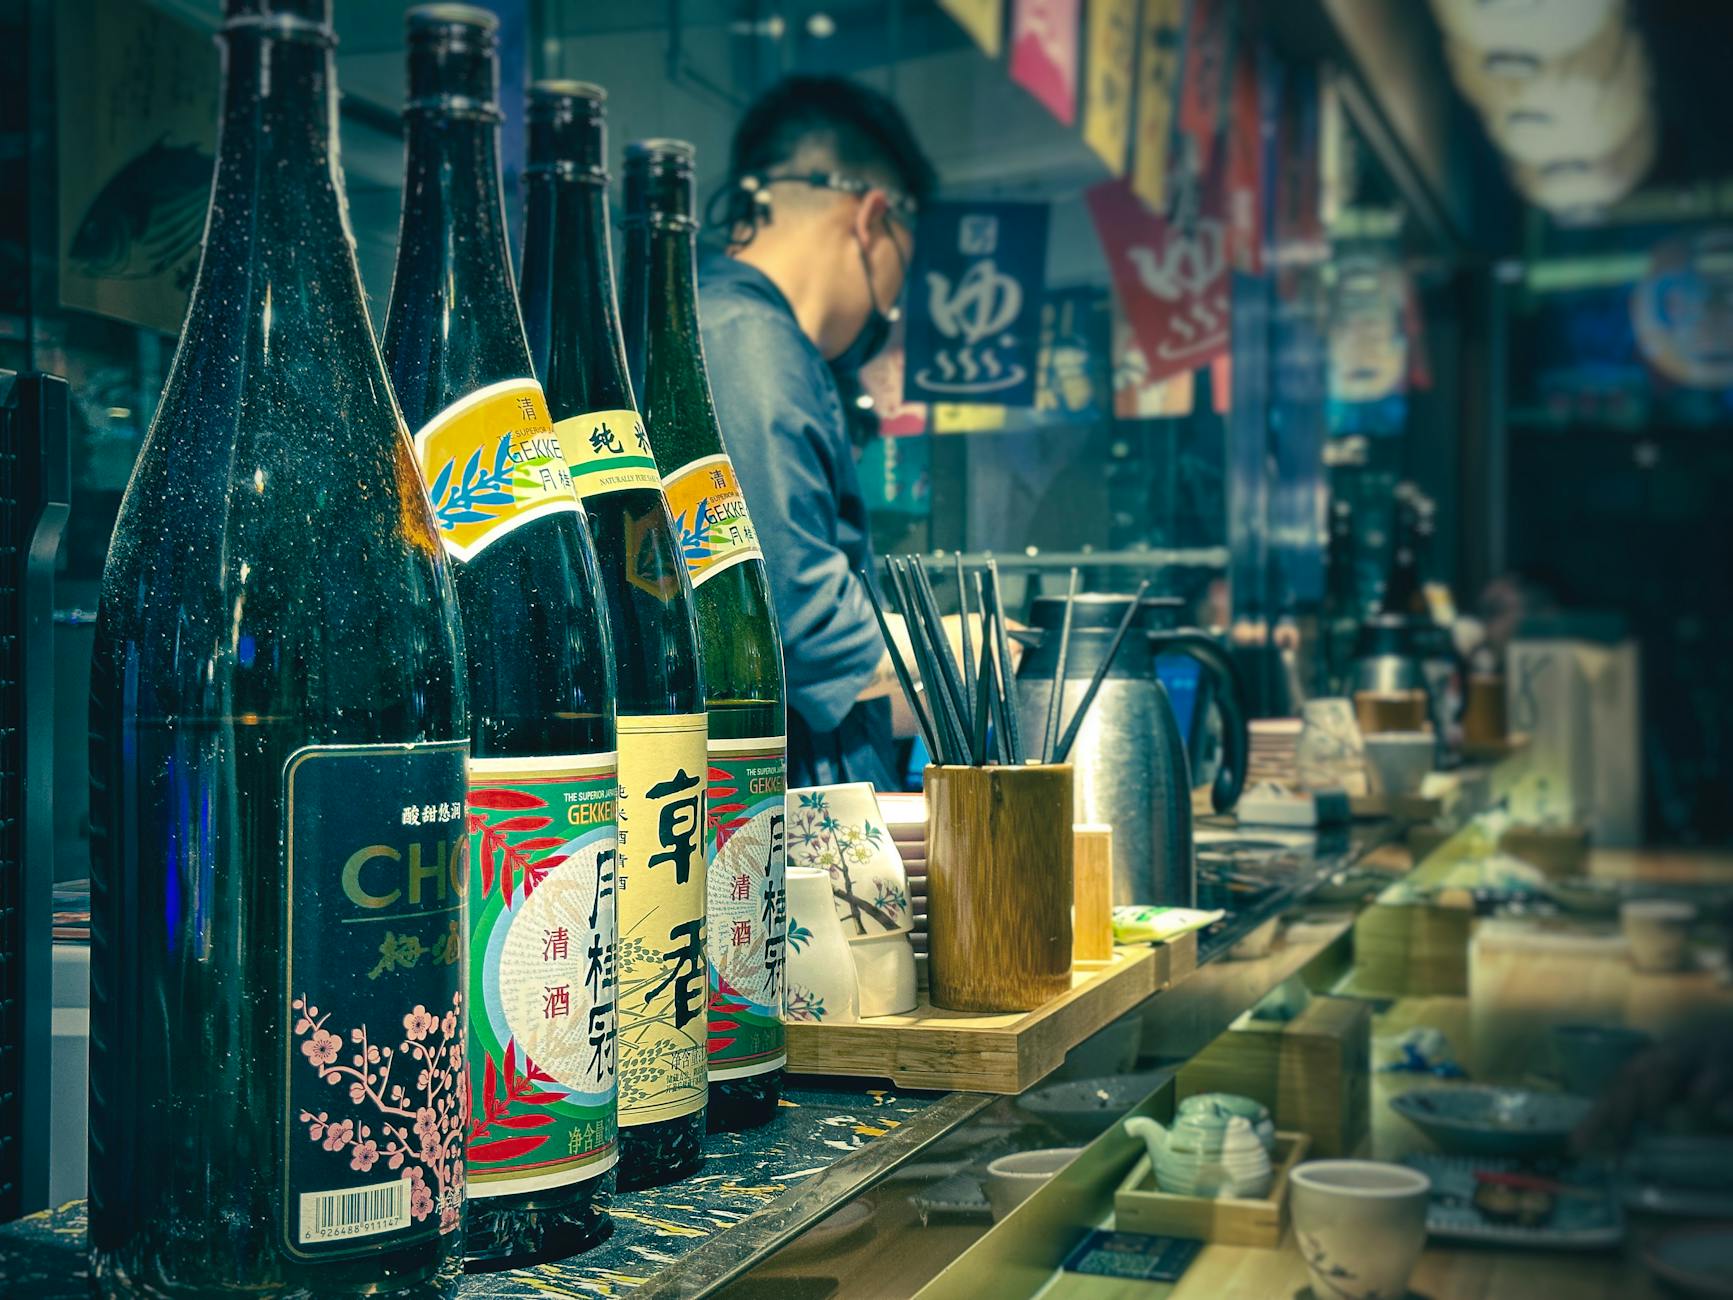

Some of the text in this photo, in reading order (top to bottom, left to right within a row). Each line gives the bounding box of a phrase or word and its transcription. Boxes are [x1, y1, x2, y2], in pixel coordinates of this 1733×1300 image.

[926, 258, 1024, 343] ゆ
[516, 397, 537, 421] 清
[709, 469, 727, 489] 清
[563, 792, 578, 802] THE
[578, 790, 605, 802] SUPERIOR
[731, 873, 752, 947] 清酒
[542, 926, 570, 1020] 清酒
[305, 1217, 399, 1239] 6 926488 911147
